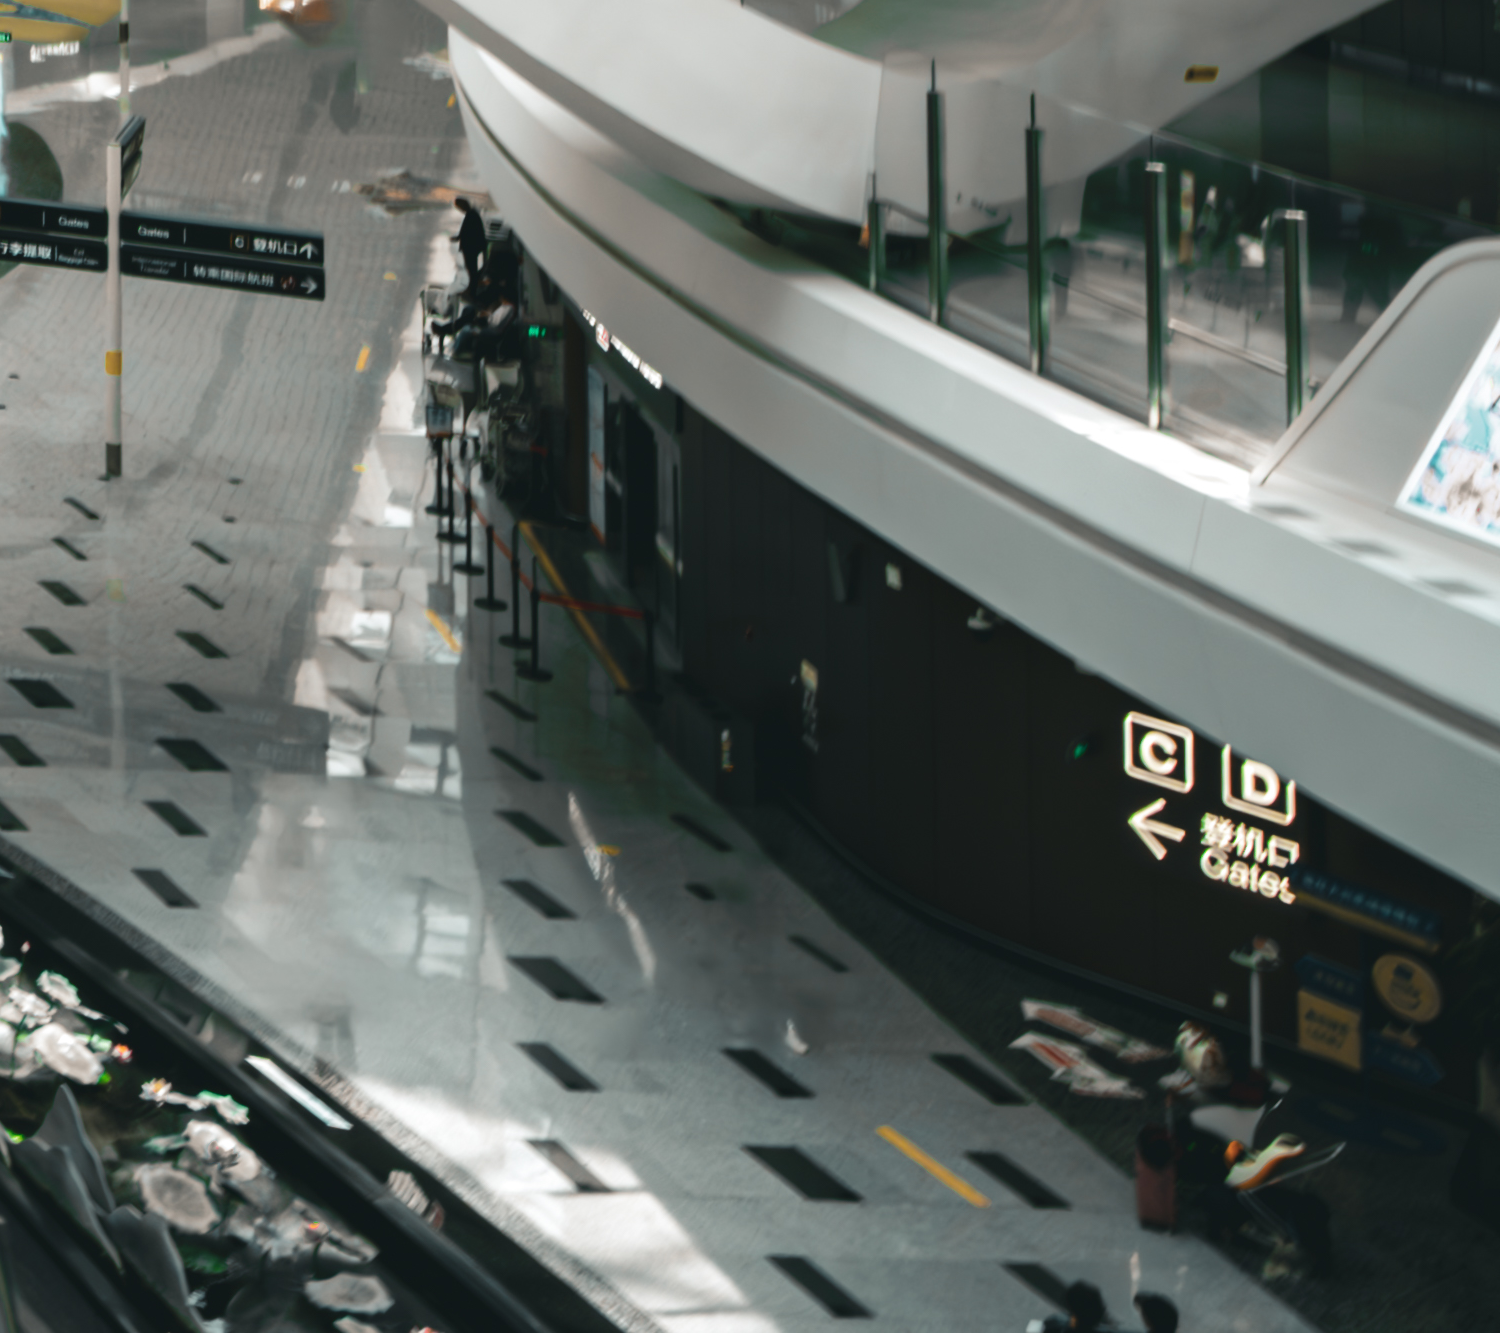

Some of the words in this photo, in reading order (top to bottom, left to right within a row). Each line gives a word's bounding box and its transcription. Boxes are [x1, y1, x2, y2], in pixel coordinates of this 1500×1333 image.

[58, 214, 90, 230] Gates
[253, 237, 298, 257] 登机口
[1138, 730, 1178, 776] C
[1240, 758, 1281, 807] D
[1200, 812, 1300, 869] 登机口
[1200, 845, 1296, 905] Gates
